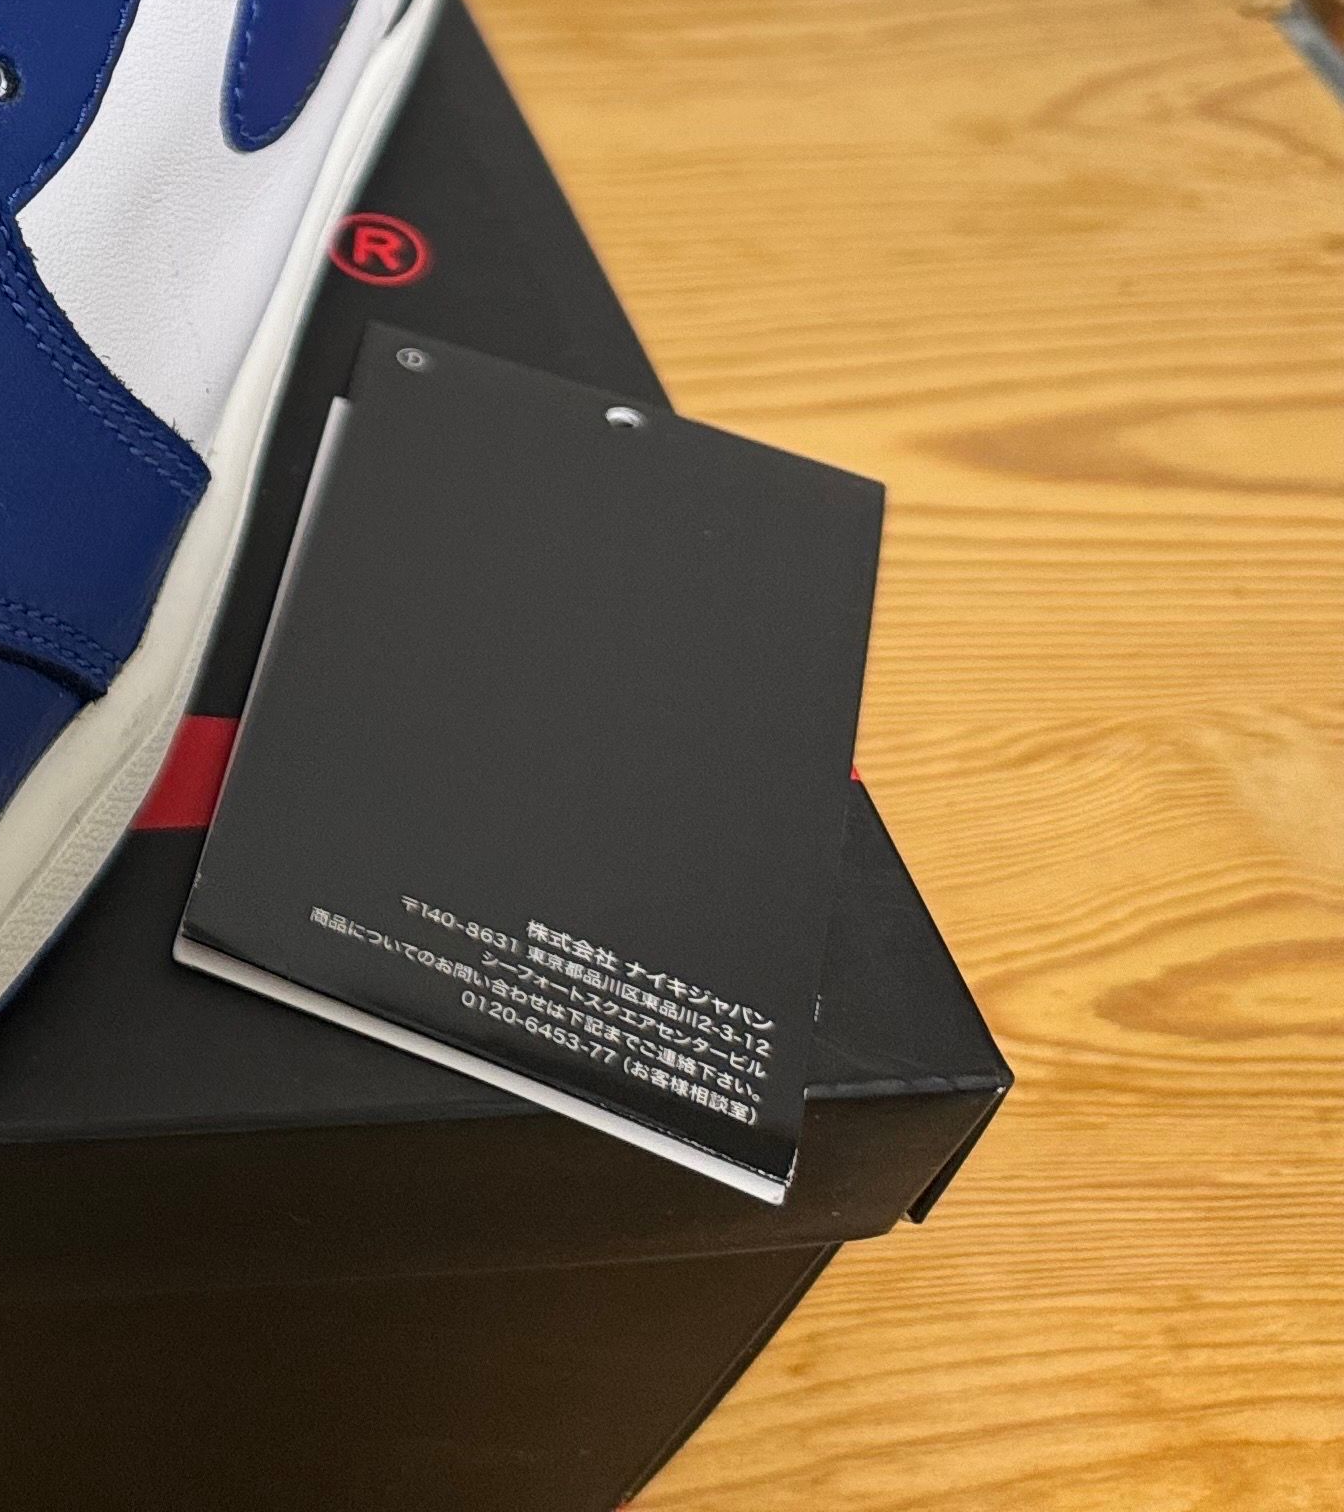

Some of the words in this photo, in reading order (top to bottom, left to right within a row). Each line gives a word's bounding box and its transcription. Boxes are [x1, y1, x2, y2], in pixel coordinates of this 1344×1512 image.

[461, 989, 617, 1065] 0120-6453-77
[623, 961, 774, 1031] ナイキジャパン
